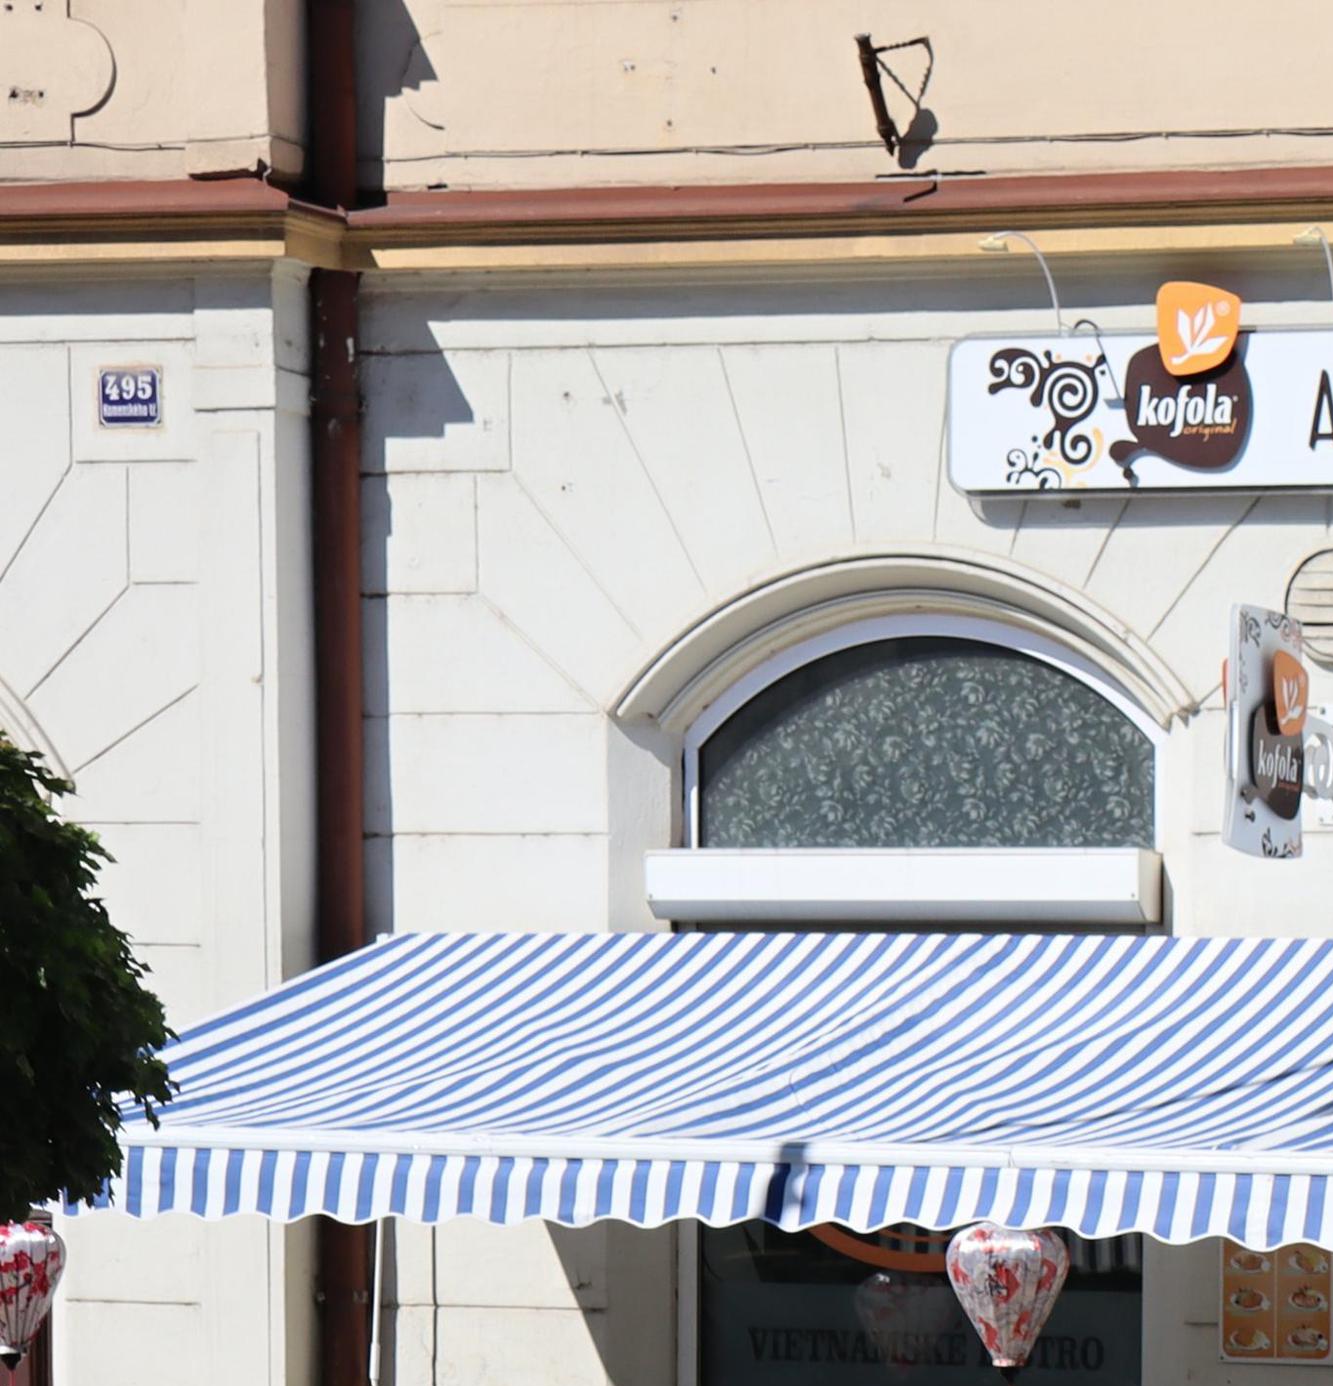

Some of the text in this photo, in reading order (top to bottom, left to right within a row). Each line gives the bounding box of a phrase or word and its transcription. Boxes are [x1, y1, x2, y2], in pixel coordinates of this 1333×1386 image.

[104, 375, 153, 401] 495
[1136, 382, 1233, 438] kofola
[1182, 418, 1238, 442] original
[1257, 739, 1299, 789] kofola
[976, 1334, 1105, 1371] TRO
